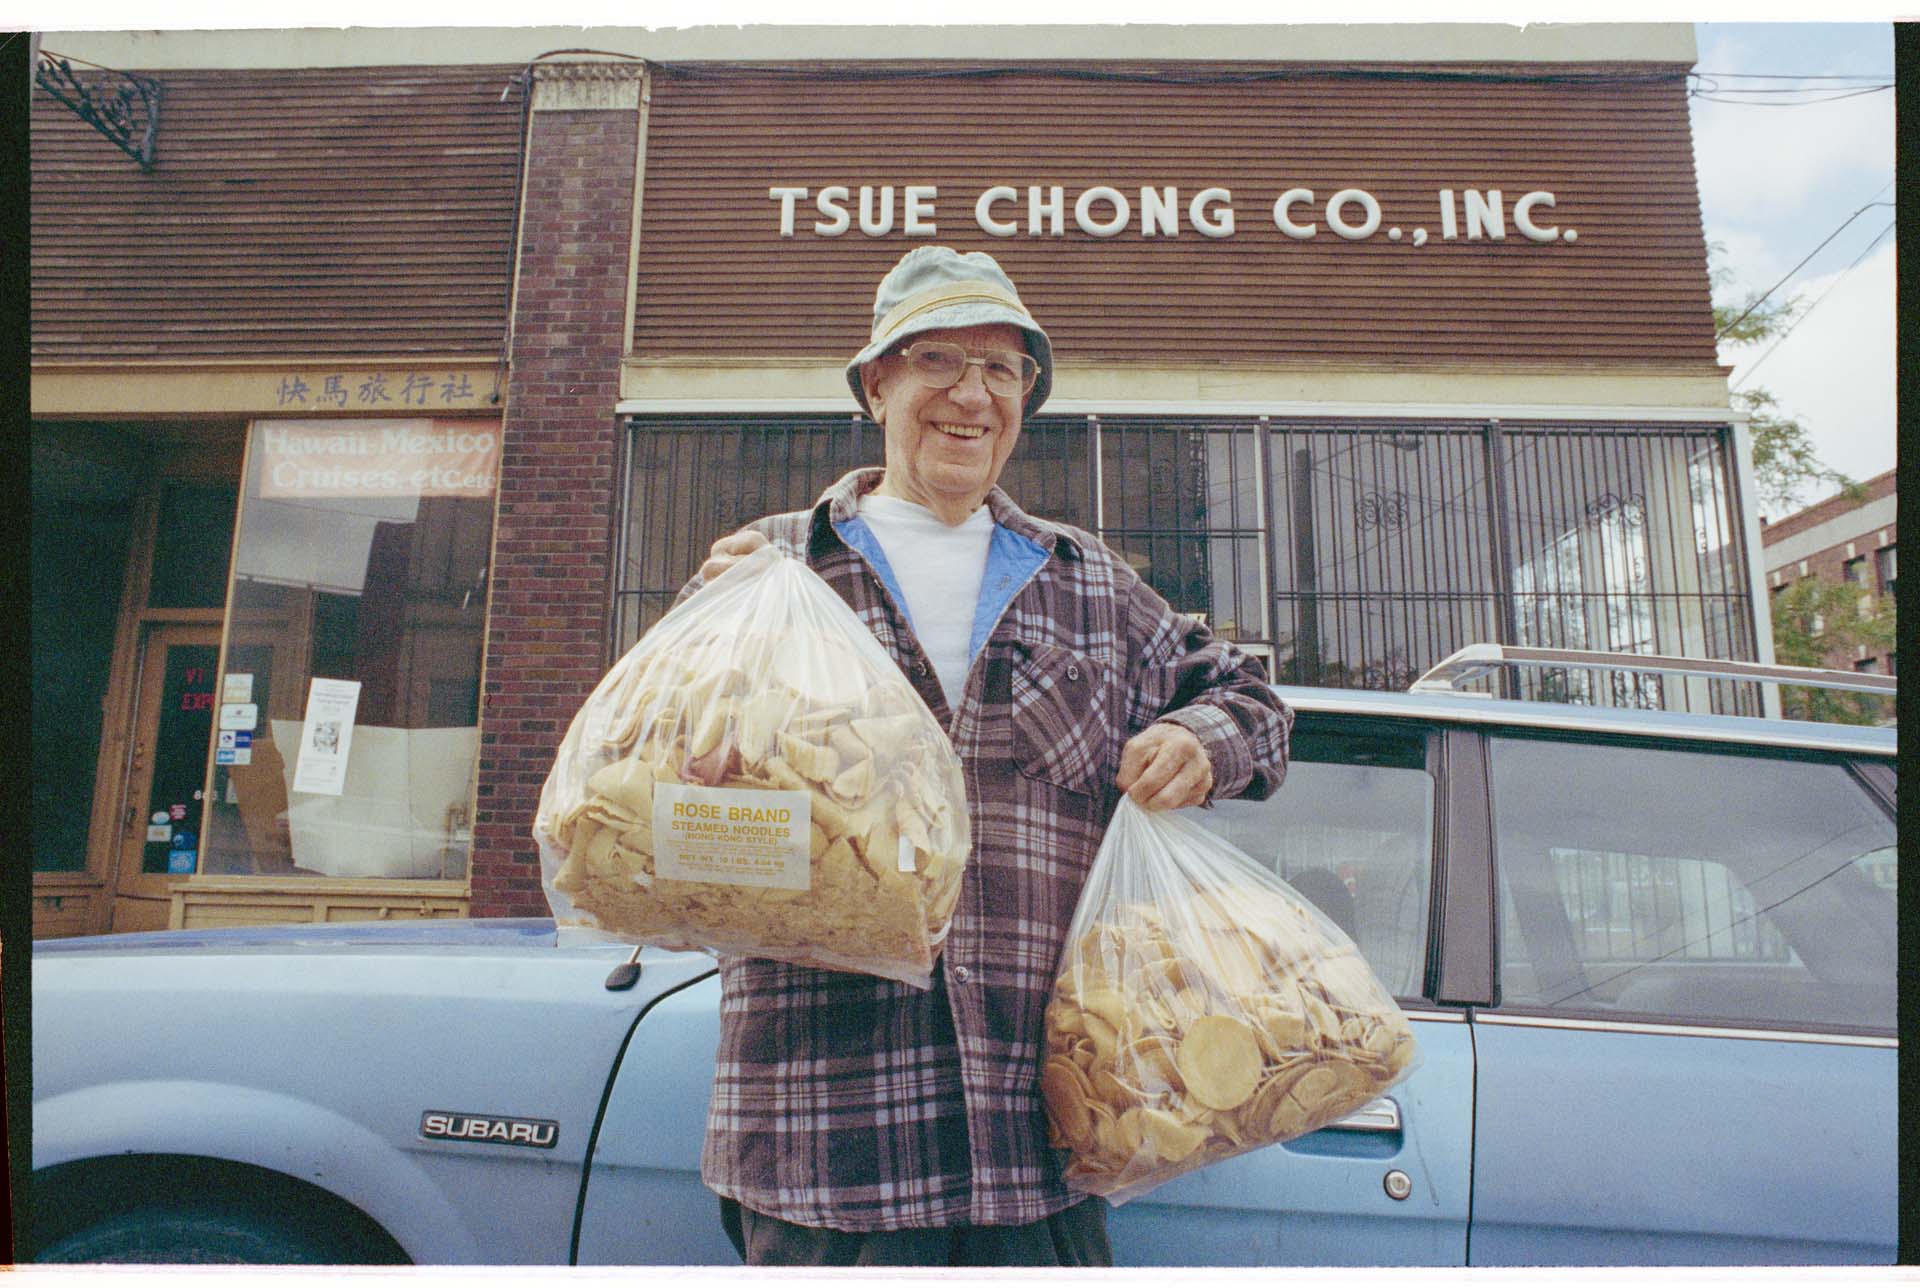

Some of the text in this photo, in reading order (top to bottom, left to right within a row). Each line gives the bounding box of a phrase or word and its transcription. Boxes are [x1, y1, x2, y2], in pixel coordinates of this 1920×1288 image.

[768, 185, 938, 238] TSUE
[974, 185, 1236, 239] CHONG
[276, 372, 475, 407] 快馬旅行社
[673, 802, 791, 824] ROSE BRAND
[671, 820, 791, 837] STEAMED NOODLES
[717, 834, 743, 843] KONG
[425, 1115, 554, 1144] SUBARU
